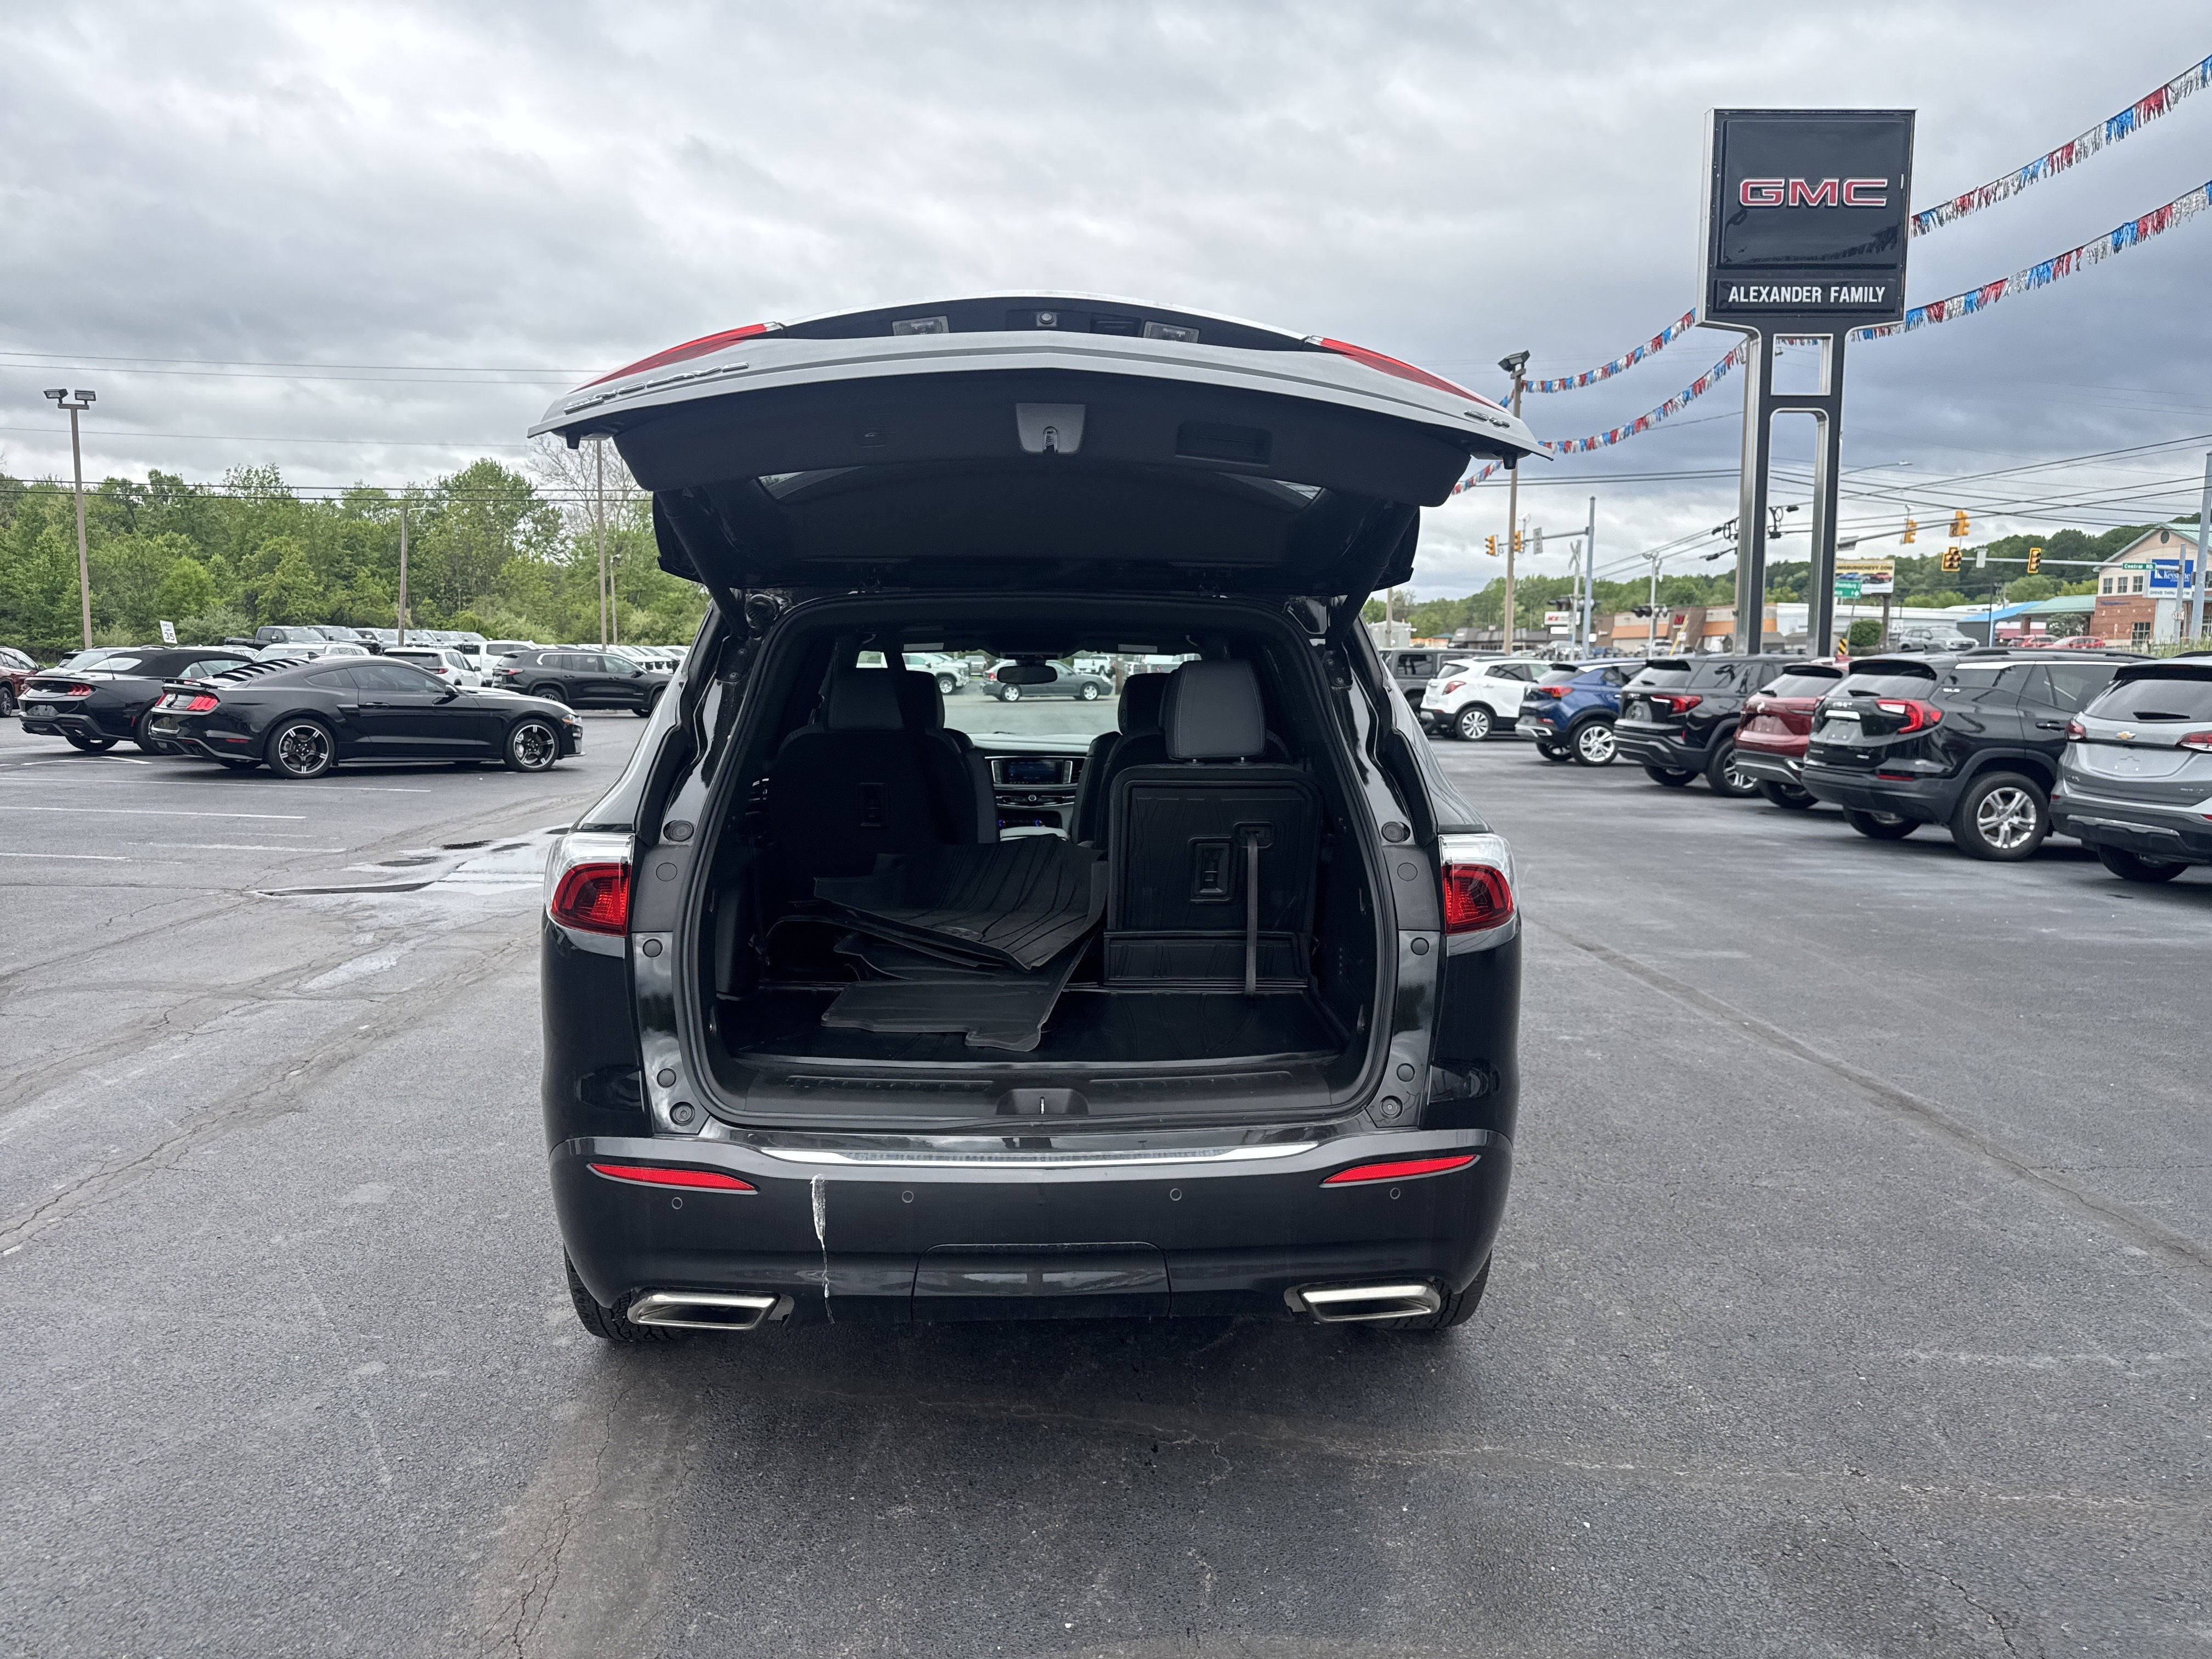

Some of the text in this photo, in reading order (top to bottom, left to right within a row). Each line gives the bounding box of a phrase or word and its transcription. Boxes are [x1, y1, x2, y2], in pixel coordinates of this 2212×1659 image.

[1739, 179, 1888, 206] GMC
[1729, 286, 1886, 303] ALEXANDER FAMILY
[165, 632, 175, 641] 35
